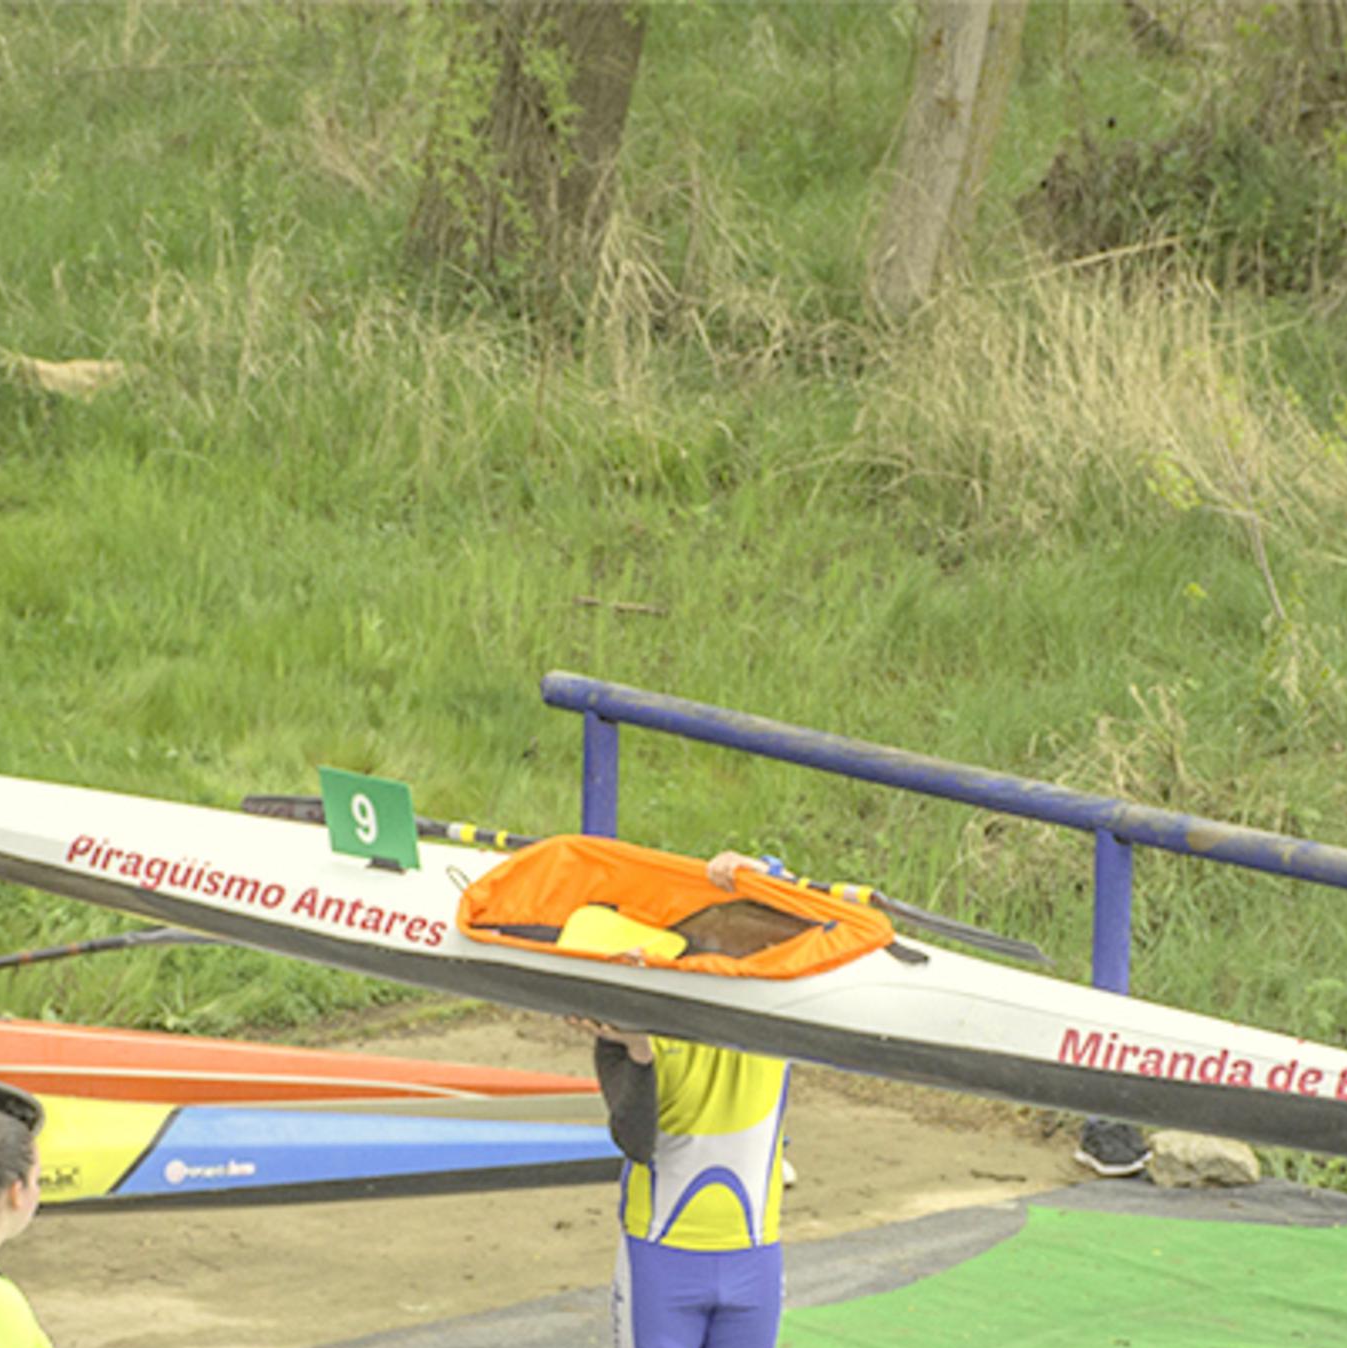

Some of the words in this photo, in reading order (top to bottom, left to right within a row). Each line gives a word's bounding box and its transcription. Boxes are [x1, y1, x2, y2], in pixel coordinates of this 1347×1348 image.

[350, 793, 379, 845] 9
[66, 834, 286, 909] Piragüismo
[290, 887, 447, 948] Antares
[1057, 1028, 1254, 1091] Miranda
[1266, 1058, 1324, 1098] de
